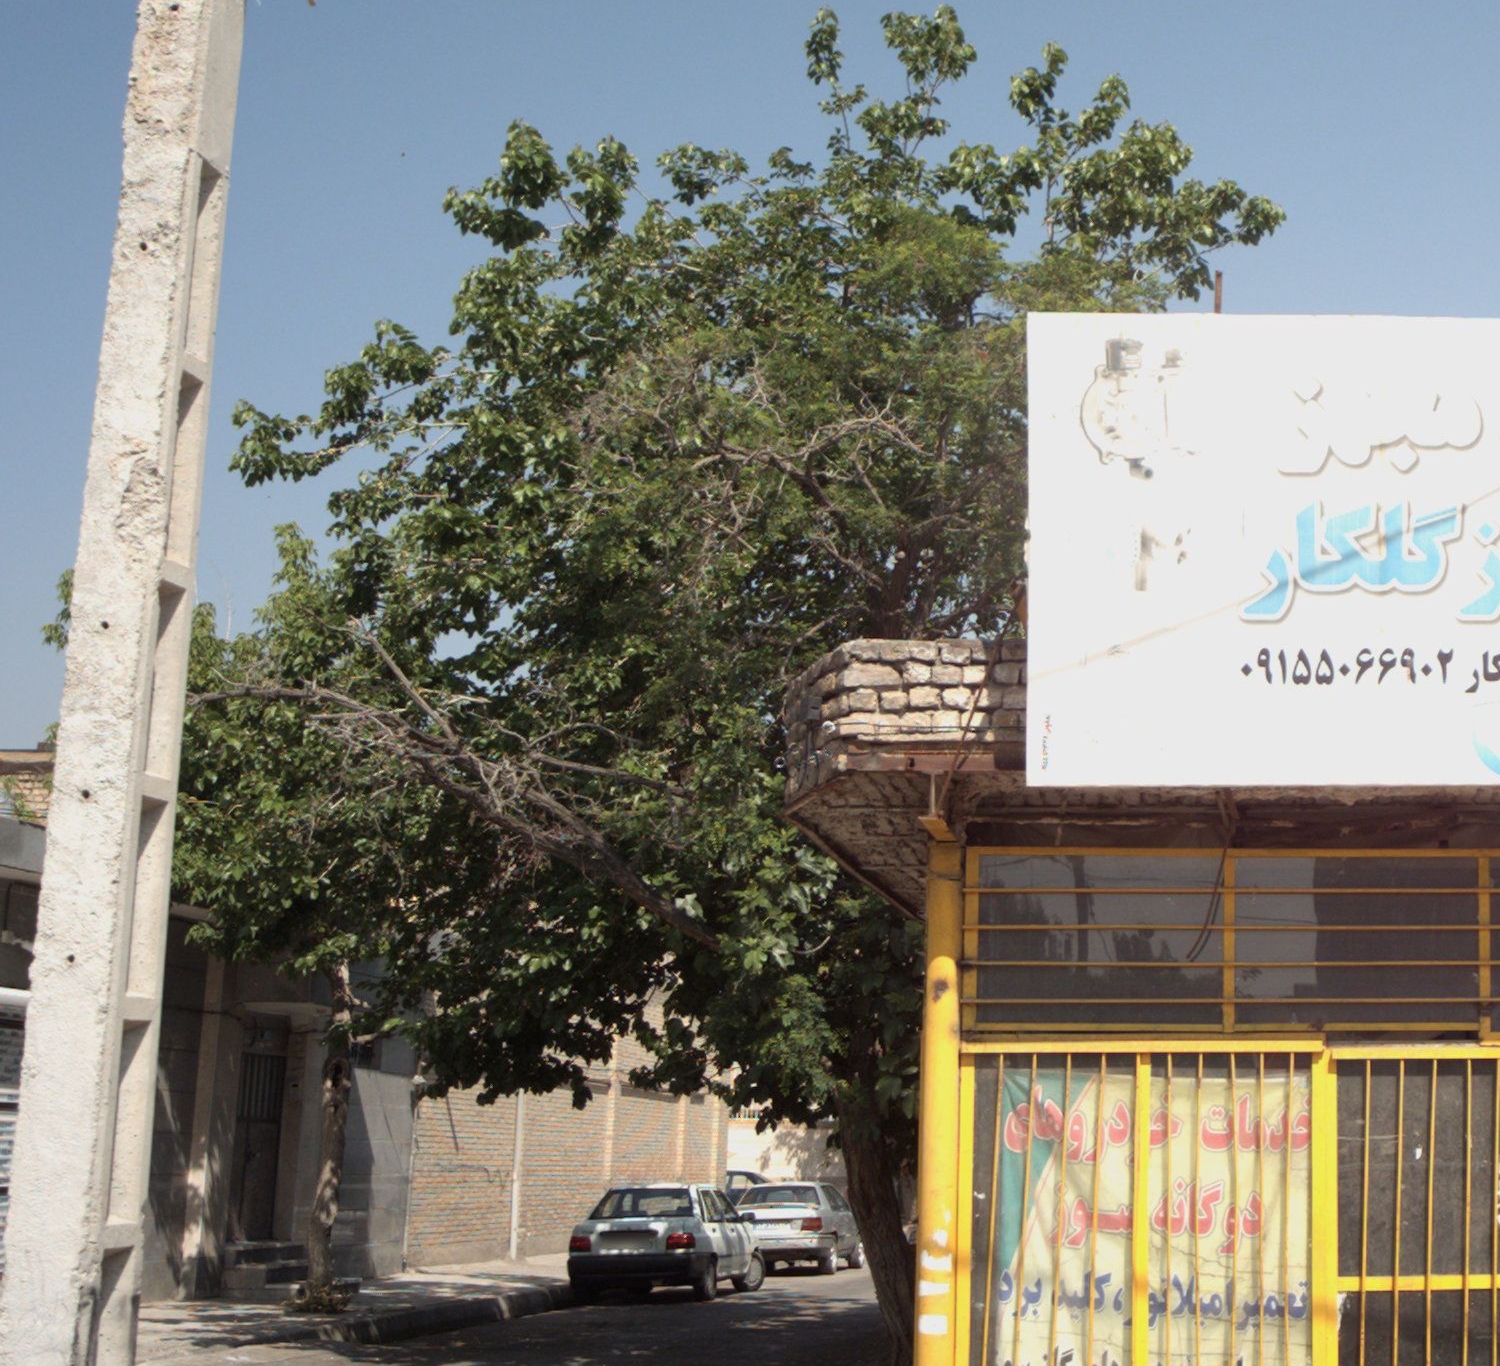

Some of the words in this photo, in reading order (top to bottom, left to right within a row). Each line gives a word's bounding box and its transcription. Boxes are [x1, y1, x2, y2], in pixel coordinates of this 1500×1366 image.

[1240, 498, 1464, 621] گلکار
[1240, 646, 1455, 686] ۰۹۱۵۵۰۶۶۹۰۲
[1003, 1084, 1183, 1166] خدروهای
[1200, 1092, 1312, 1153] خدمات
